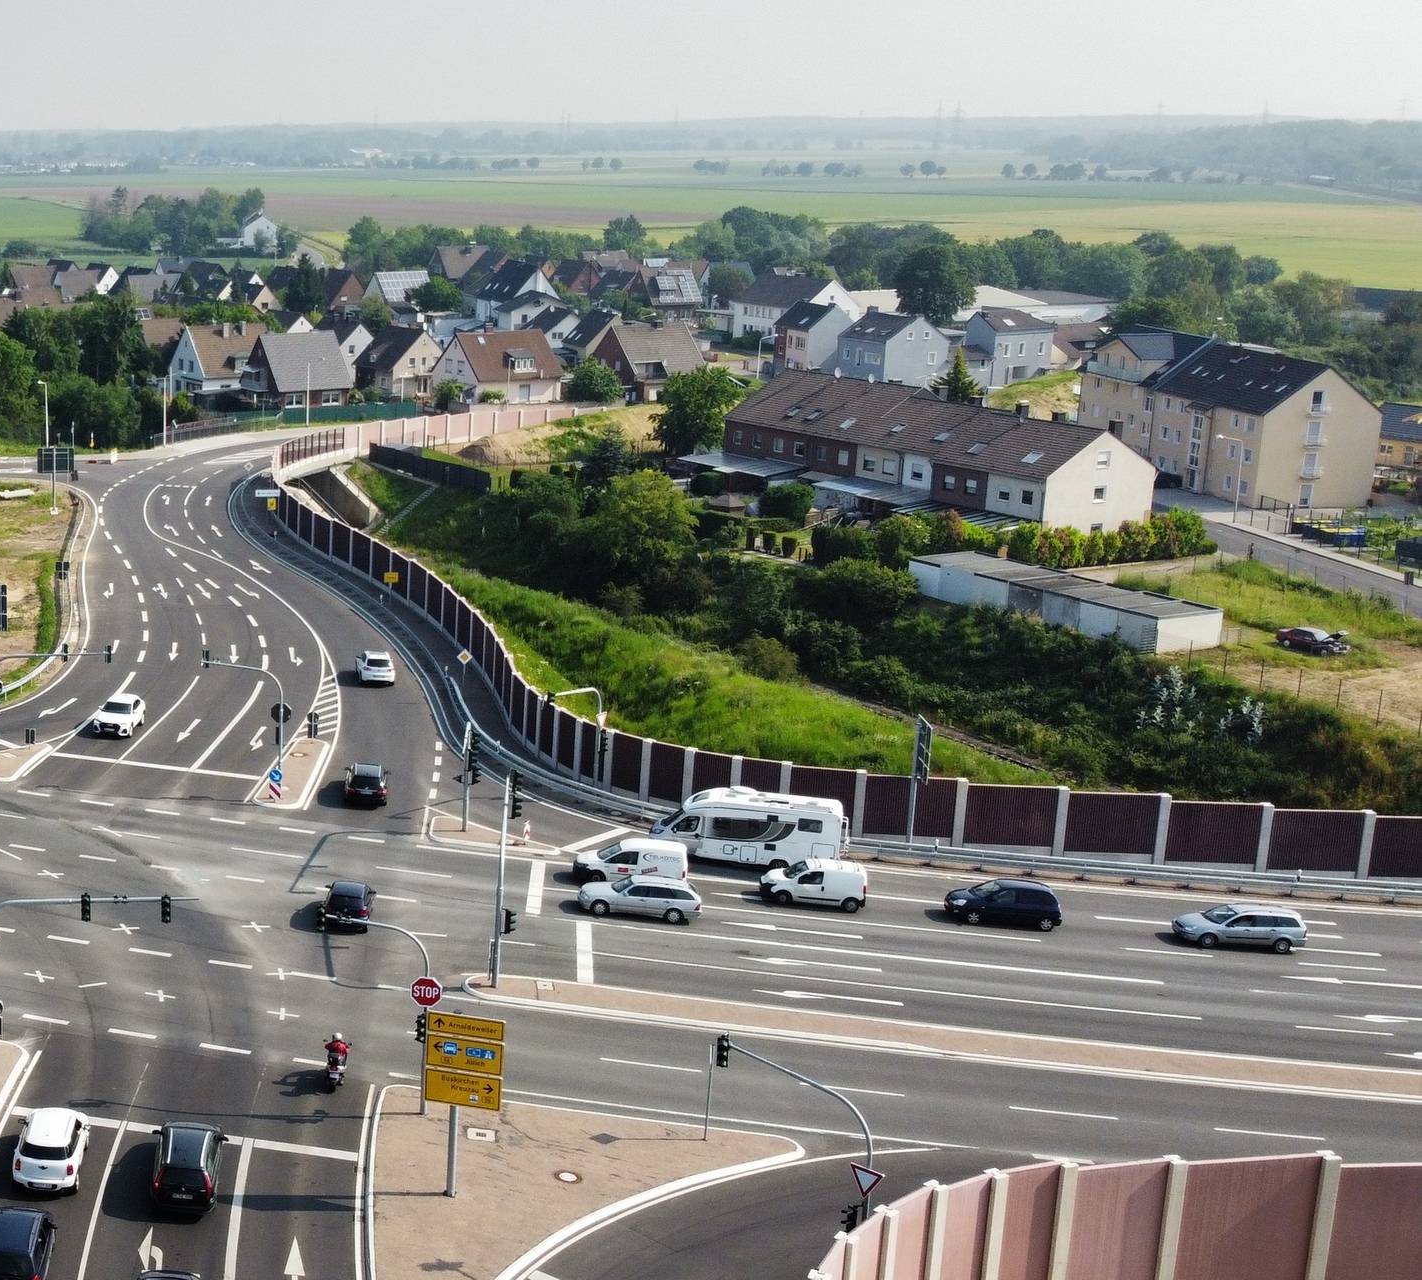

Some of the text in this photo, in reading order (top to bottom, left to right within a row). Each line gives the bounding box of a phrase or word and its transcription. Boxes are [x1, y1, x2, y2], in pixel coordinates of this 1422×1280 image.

[413, 985, 439, 999] STOP
[448, 1021, 498, 1034] Arnoldsweiler
[441, 1074, 480, 1086] Euskirchen
